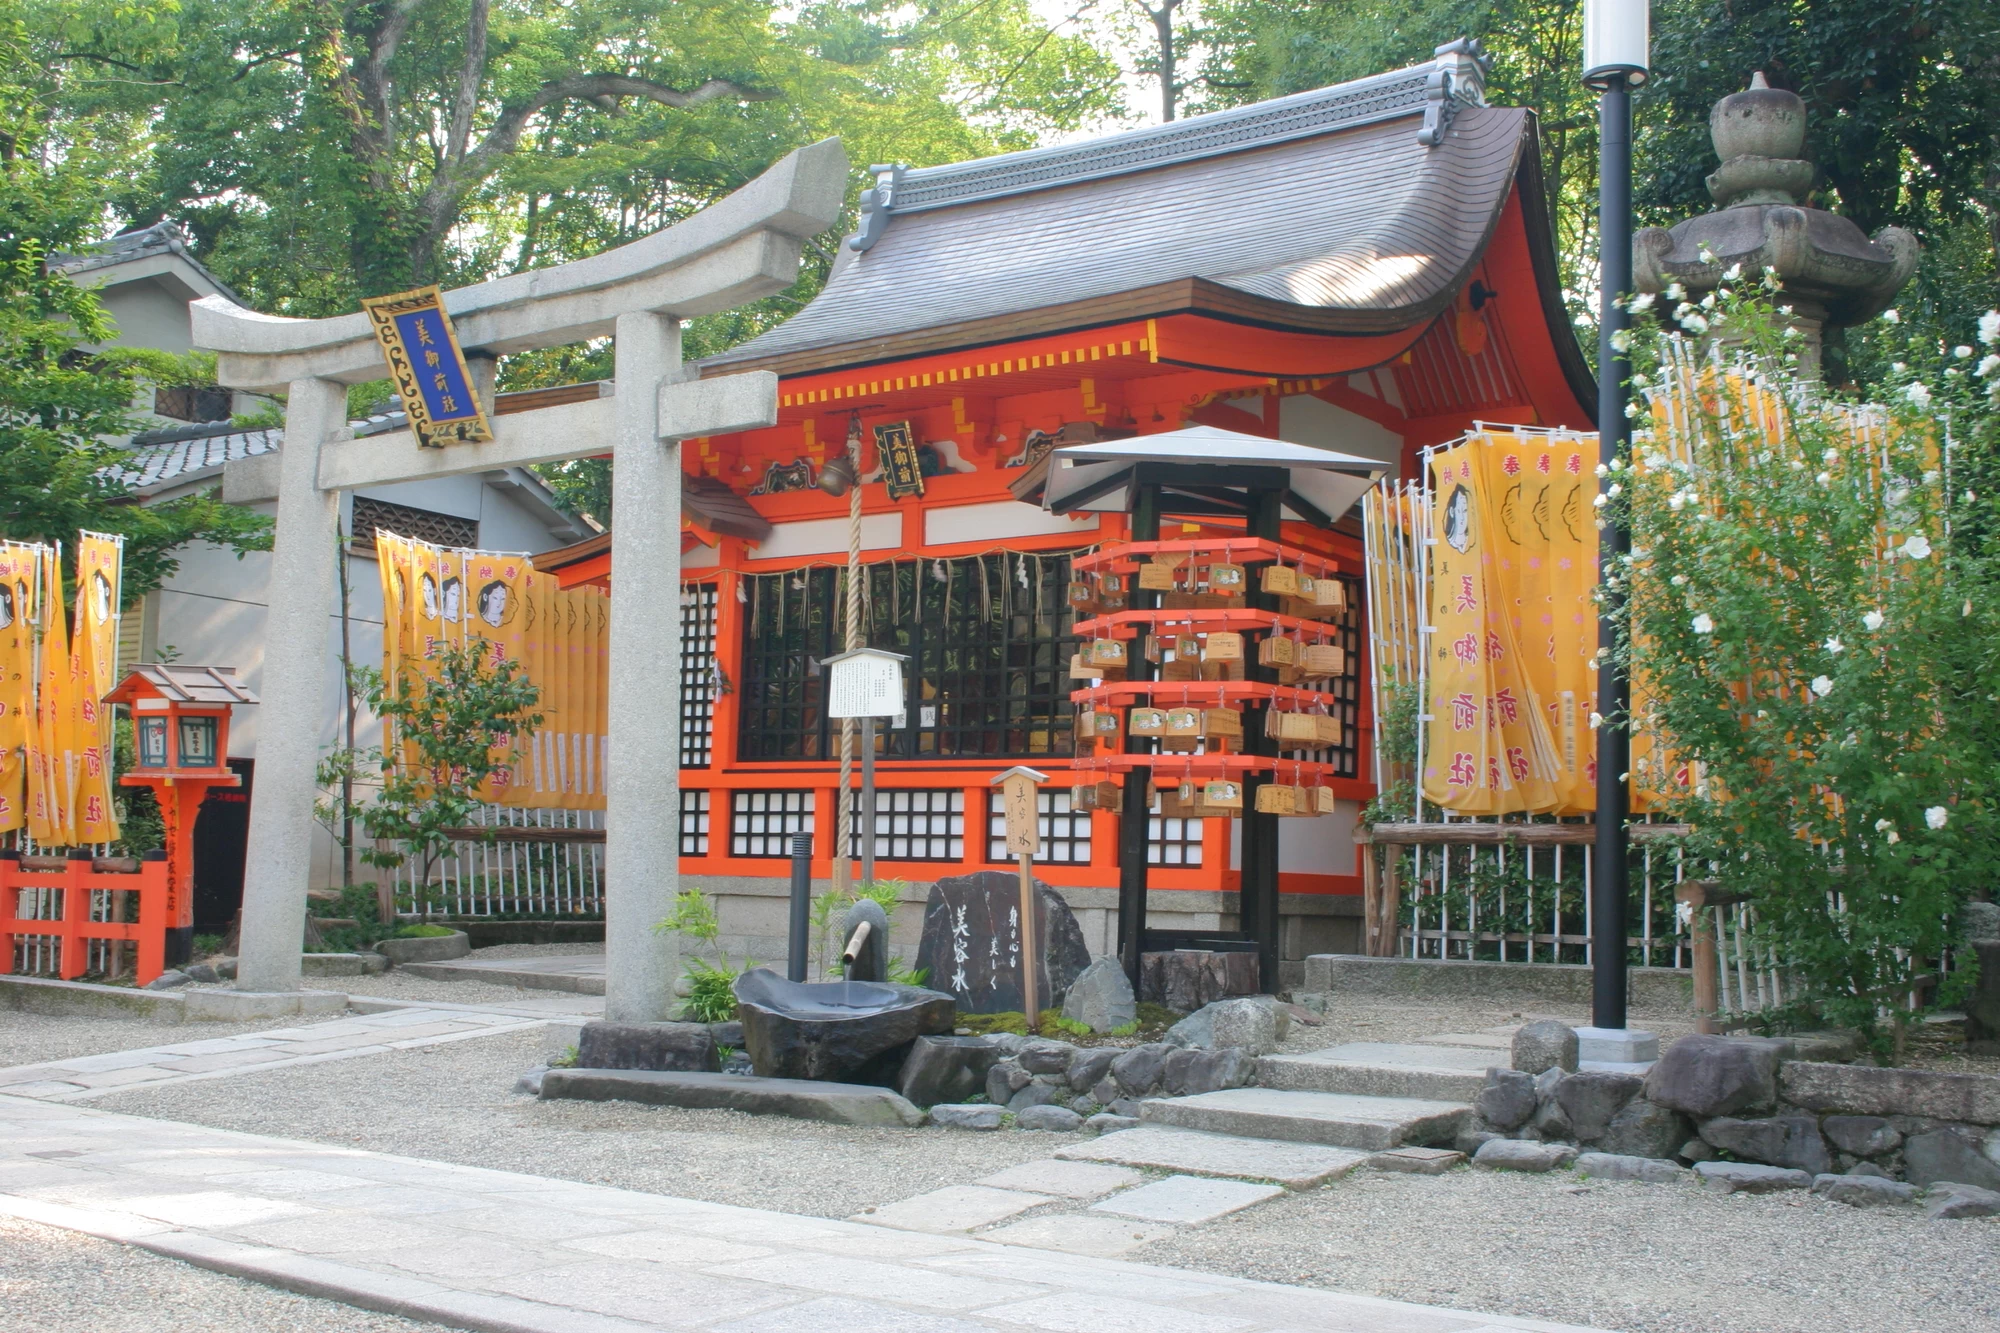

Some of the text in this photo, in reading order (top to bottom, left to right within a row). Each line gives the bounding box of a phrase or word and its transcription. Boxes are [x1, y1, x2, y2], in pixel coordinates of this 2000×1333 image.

[415, 318, 458, 413] 美御前社
[891, 432, 911, 483] 美御前
[1016, 781, 1031, 847] 美容水
[951, 905, 970, 992] 美容水
[989, 937, 999, 990] 美しく
[1009, 906, 1019, 968] 身も心も
